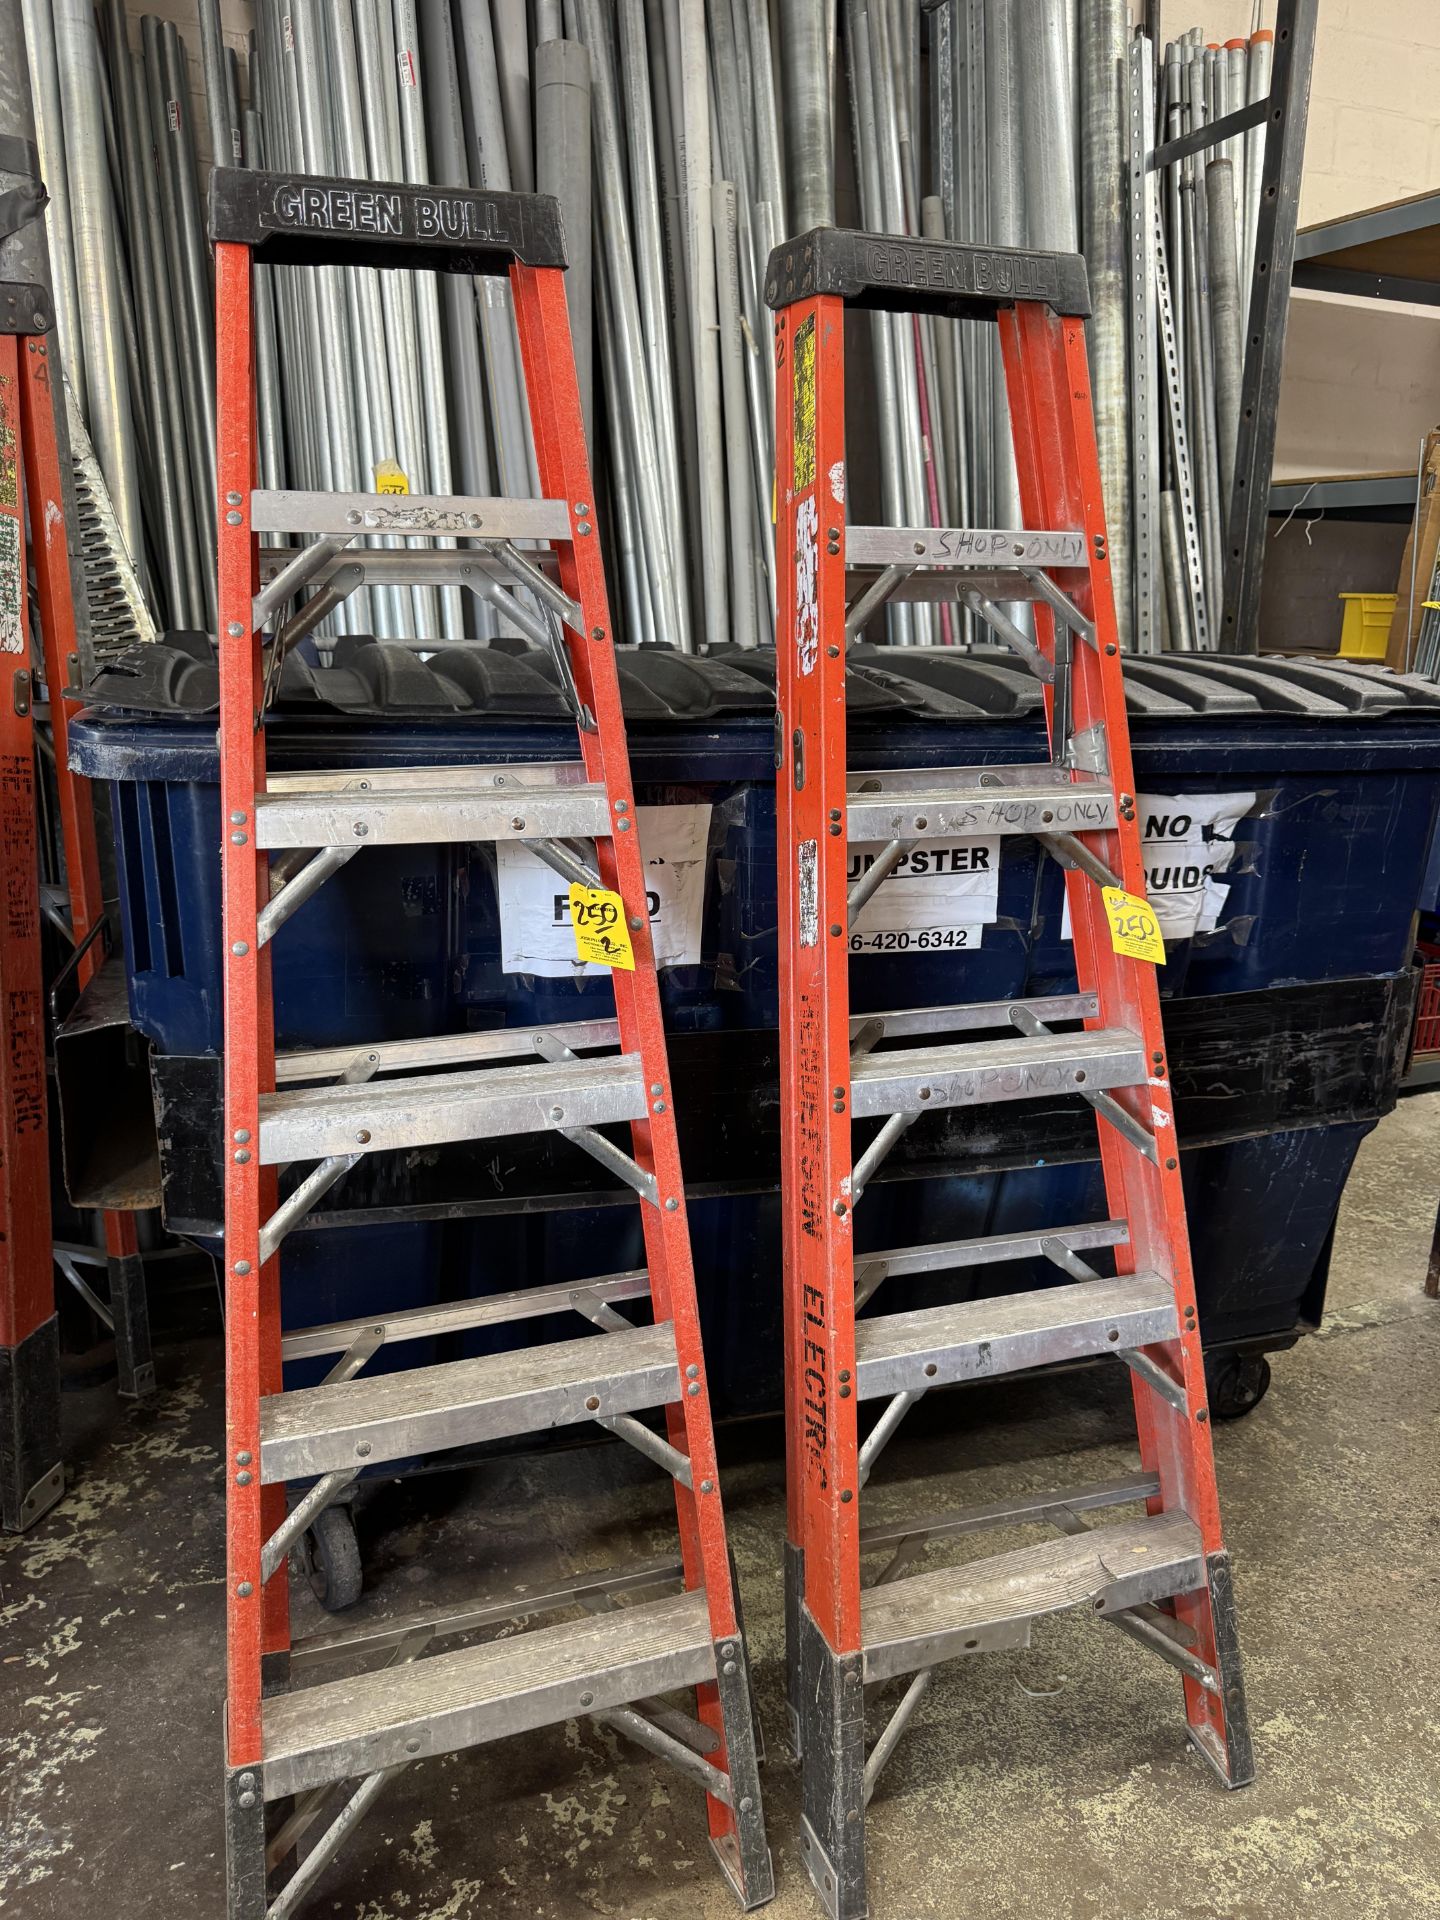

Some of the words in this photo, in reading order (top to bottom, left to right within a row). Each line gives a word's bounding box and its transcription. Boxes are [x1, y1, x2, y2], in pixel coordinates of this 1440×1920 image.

[273, 185, 402, 235] GREEN
[414, 198, 508, 243] BULL
[726, 197, 738, 233] CONDUIT
[867, 244, 965, 290] GREEN
[973, 252, 1048, 298] BULL
[932, 531, 1008, 559] SHOP
[1026, 537, 1084, 564] ONLY
[957, 801, 1037, 827] SHOP
[1056, 803, 1109, 826] ONLY
[1144, 814, 1193, 838] NO
[573, 900, 618, 926] 250
[847, 930, 968, 951] 6-420-6342
[1114, 915, 1155, 941] 250
